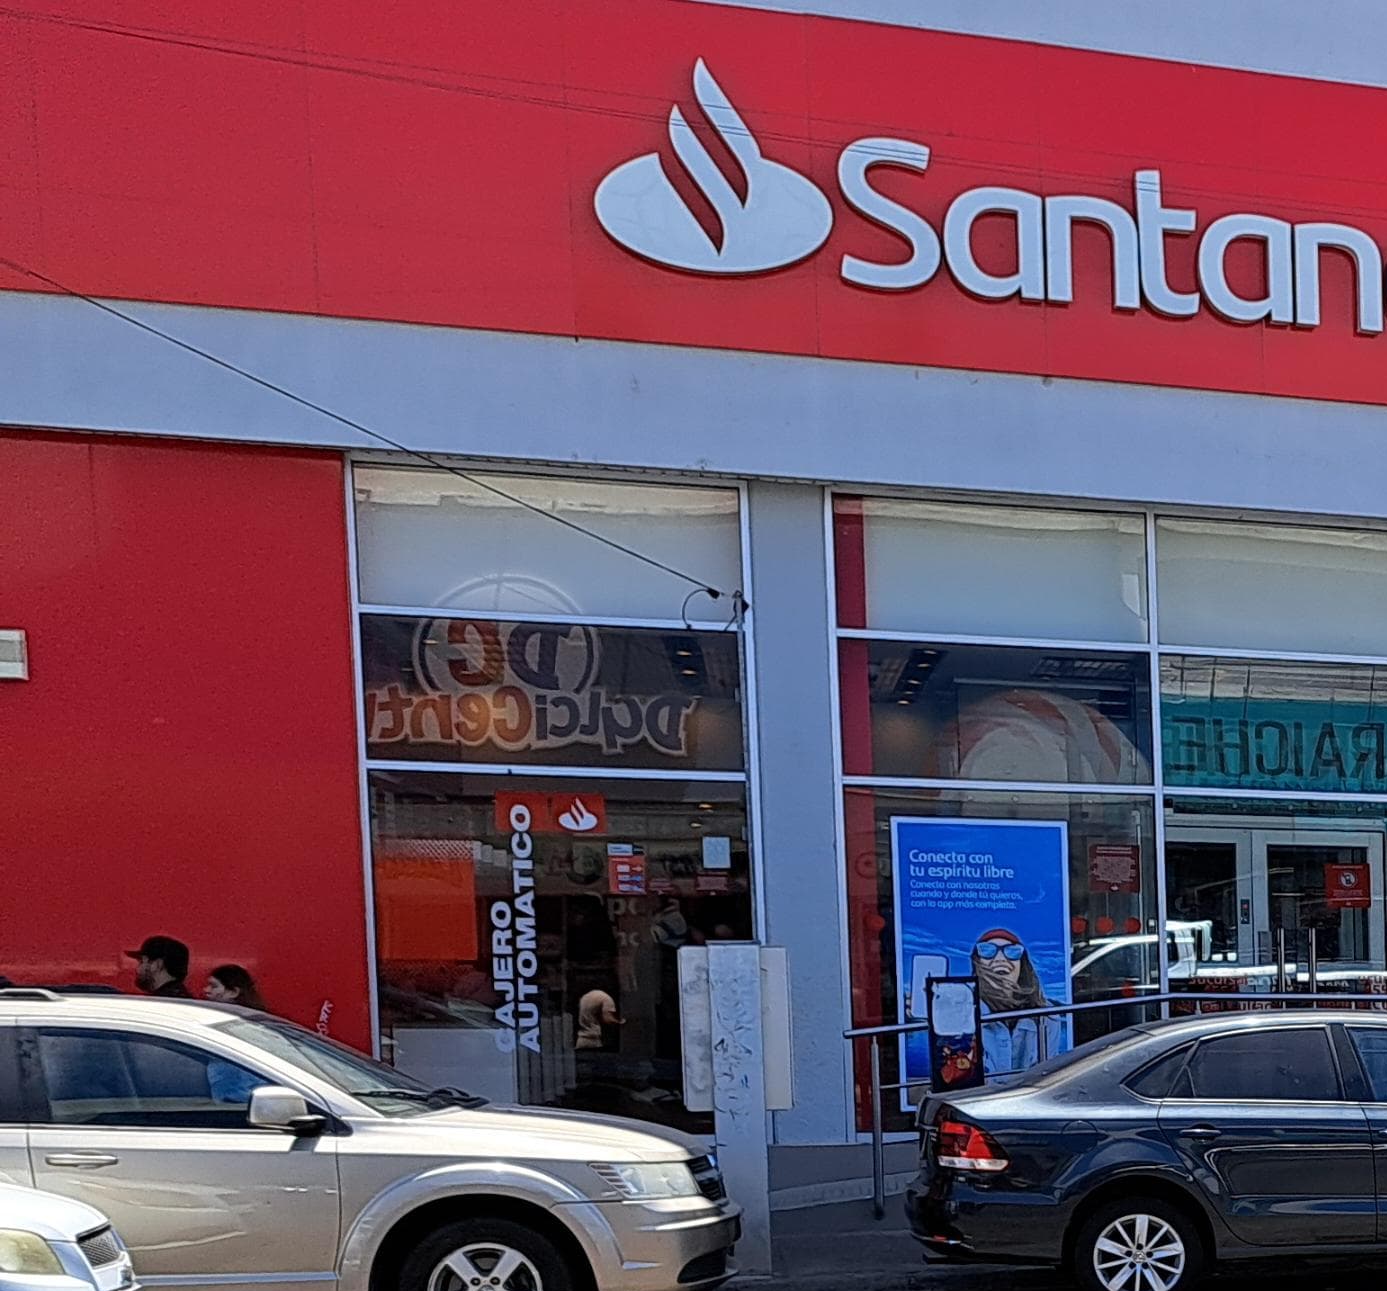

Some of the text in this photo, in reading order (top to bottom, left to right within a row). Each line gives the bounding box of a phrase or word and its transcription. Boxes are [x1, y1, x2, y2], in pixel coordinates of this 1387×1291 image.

[909, 849, 994, 864] Conecta con
[910, 864, 925, 877] tu
[983, 865, 1014, 879] libre
[910, 880, 944, 889] Conecta
[946, 881, 962, 889] con
[509, 804, 541, 1054] AUTOMATICO
[491, 901, 517, 1053] CAJERO
